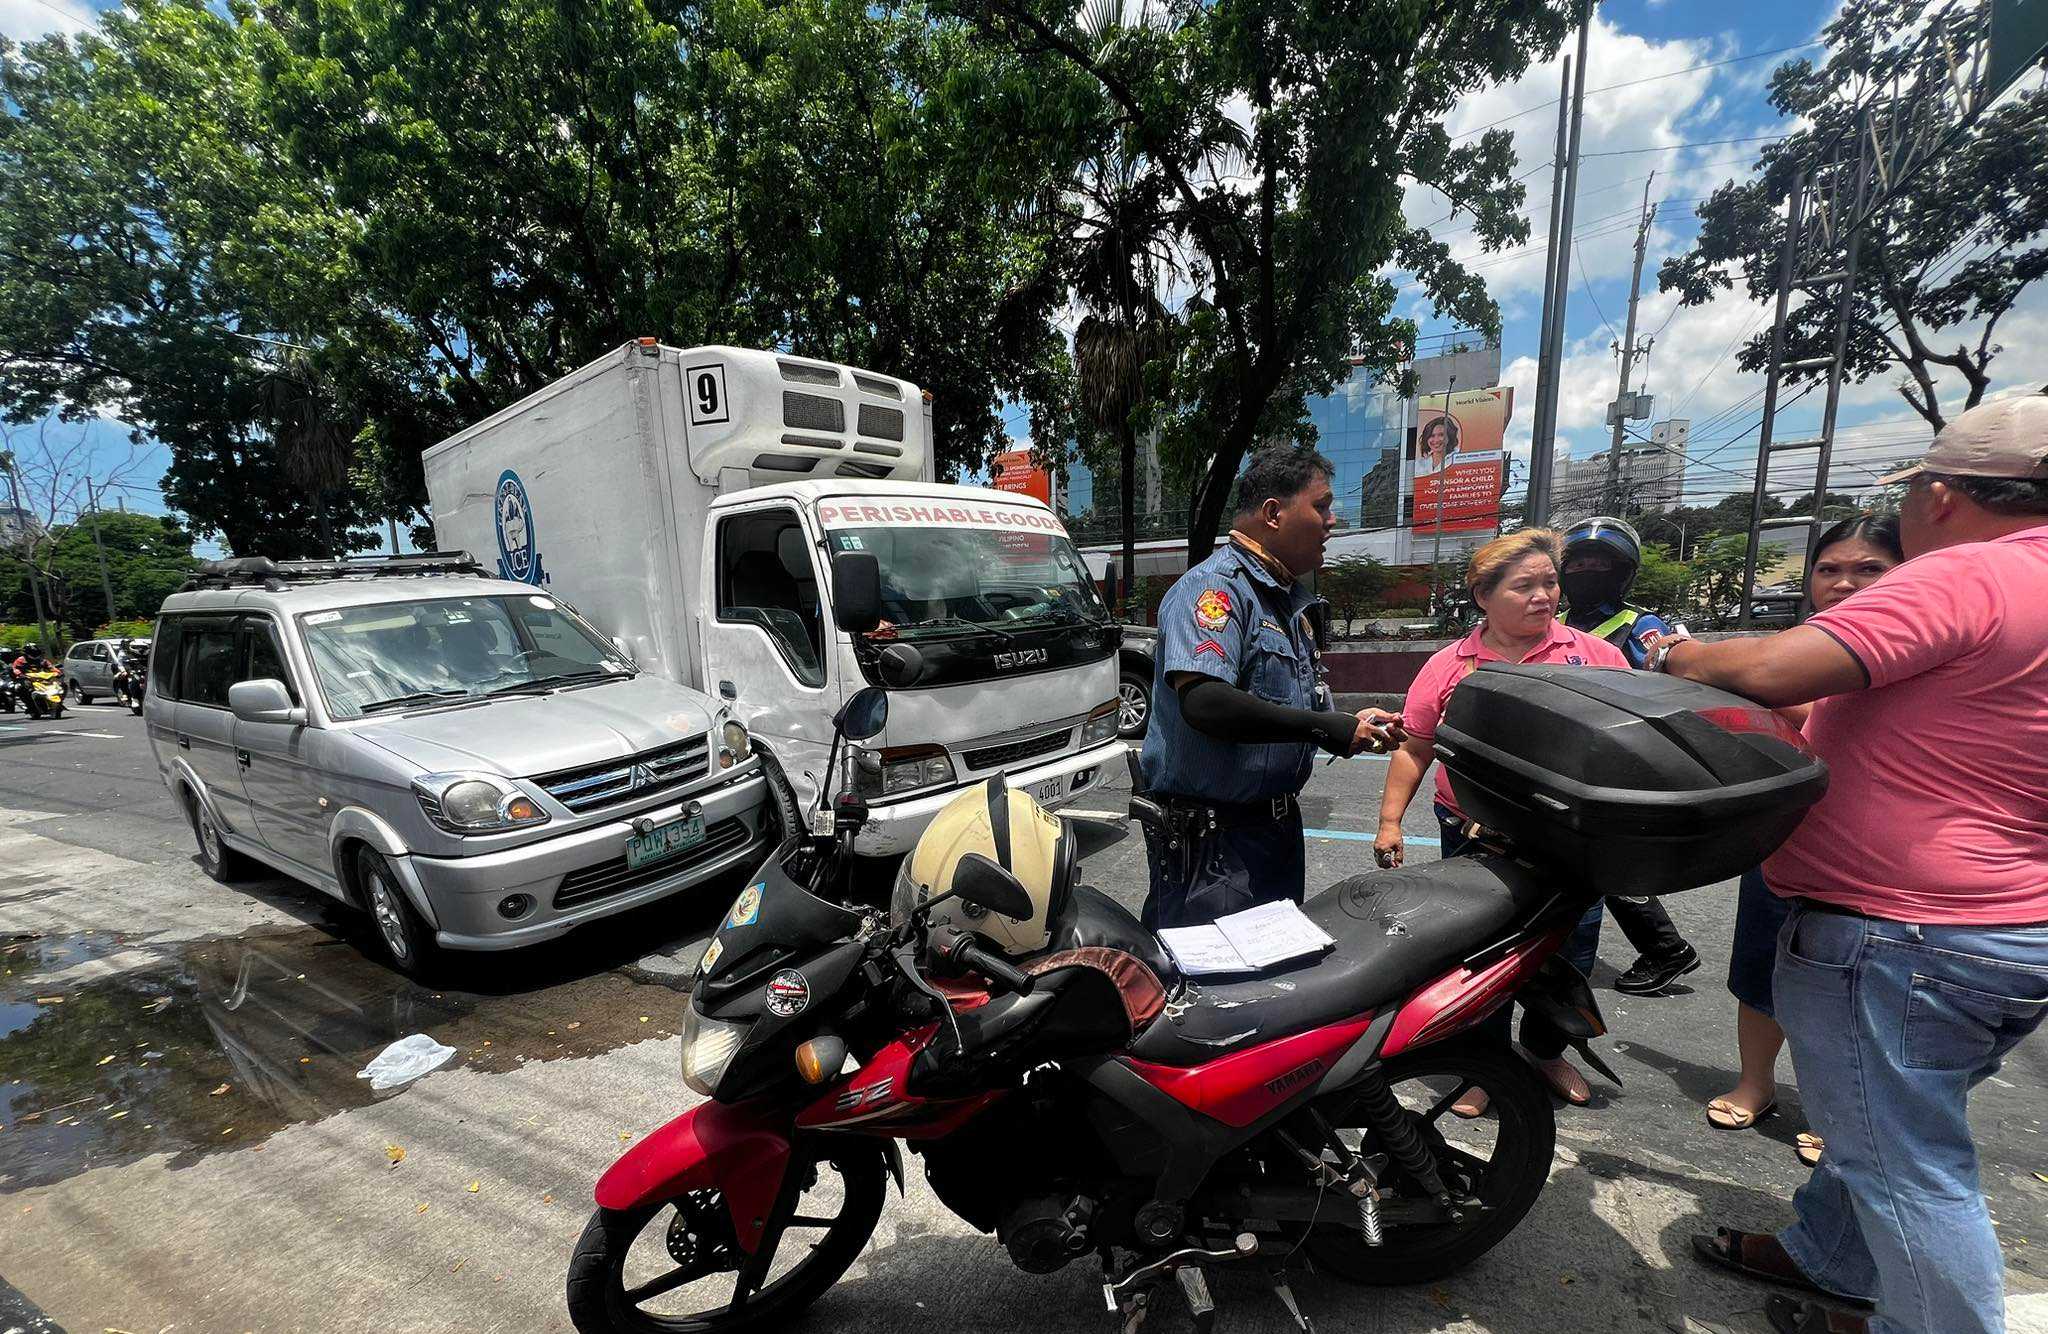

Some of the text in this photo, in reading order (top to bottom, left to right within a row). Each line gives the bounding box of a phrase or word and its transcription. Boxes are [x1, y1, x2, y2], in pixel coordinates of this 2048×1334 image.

[697, 373, 718, 414] 9
[1455, 466, 1496, 476] WHEN YOU
[1004, 482, 1027, 490] BRINGS
[1449, 492, 1480, 500] FAMILIES
[510, 550, 530, 571] ICE
[993, 648, 1048, 670] ISUZU
[1039, 781, 1061, 800] 4001
[671, 819, 699, 842] 354
[1266, 1059, 1323, 1095] YAMAHA
